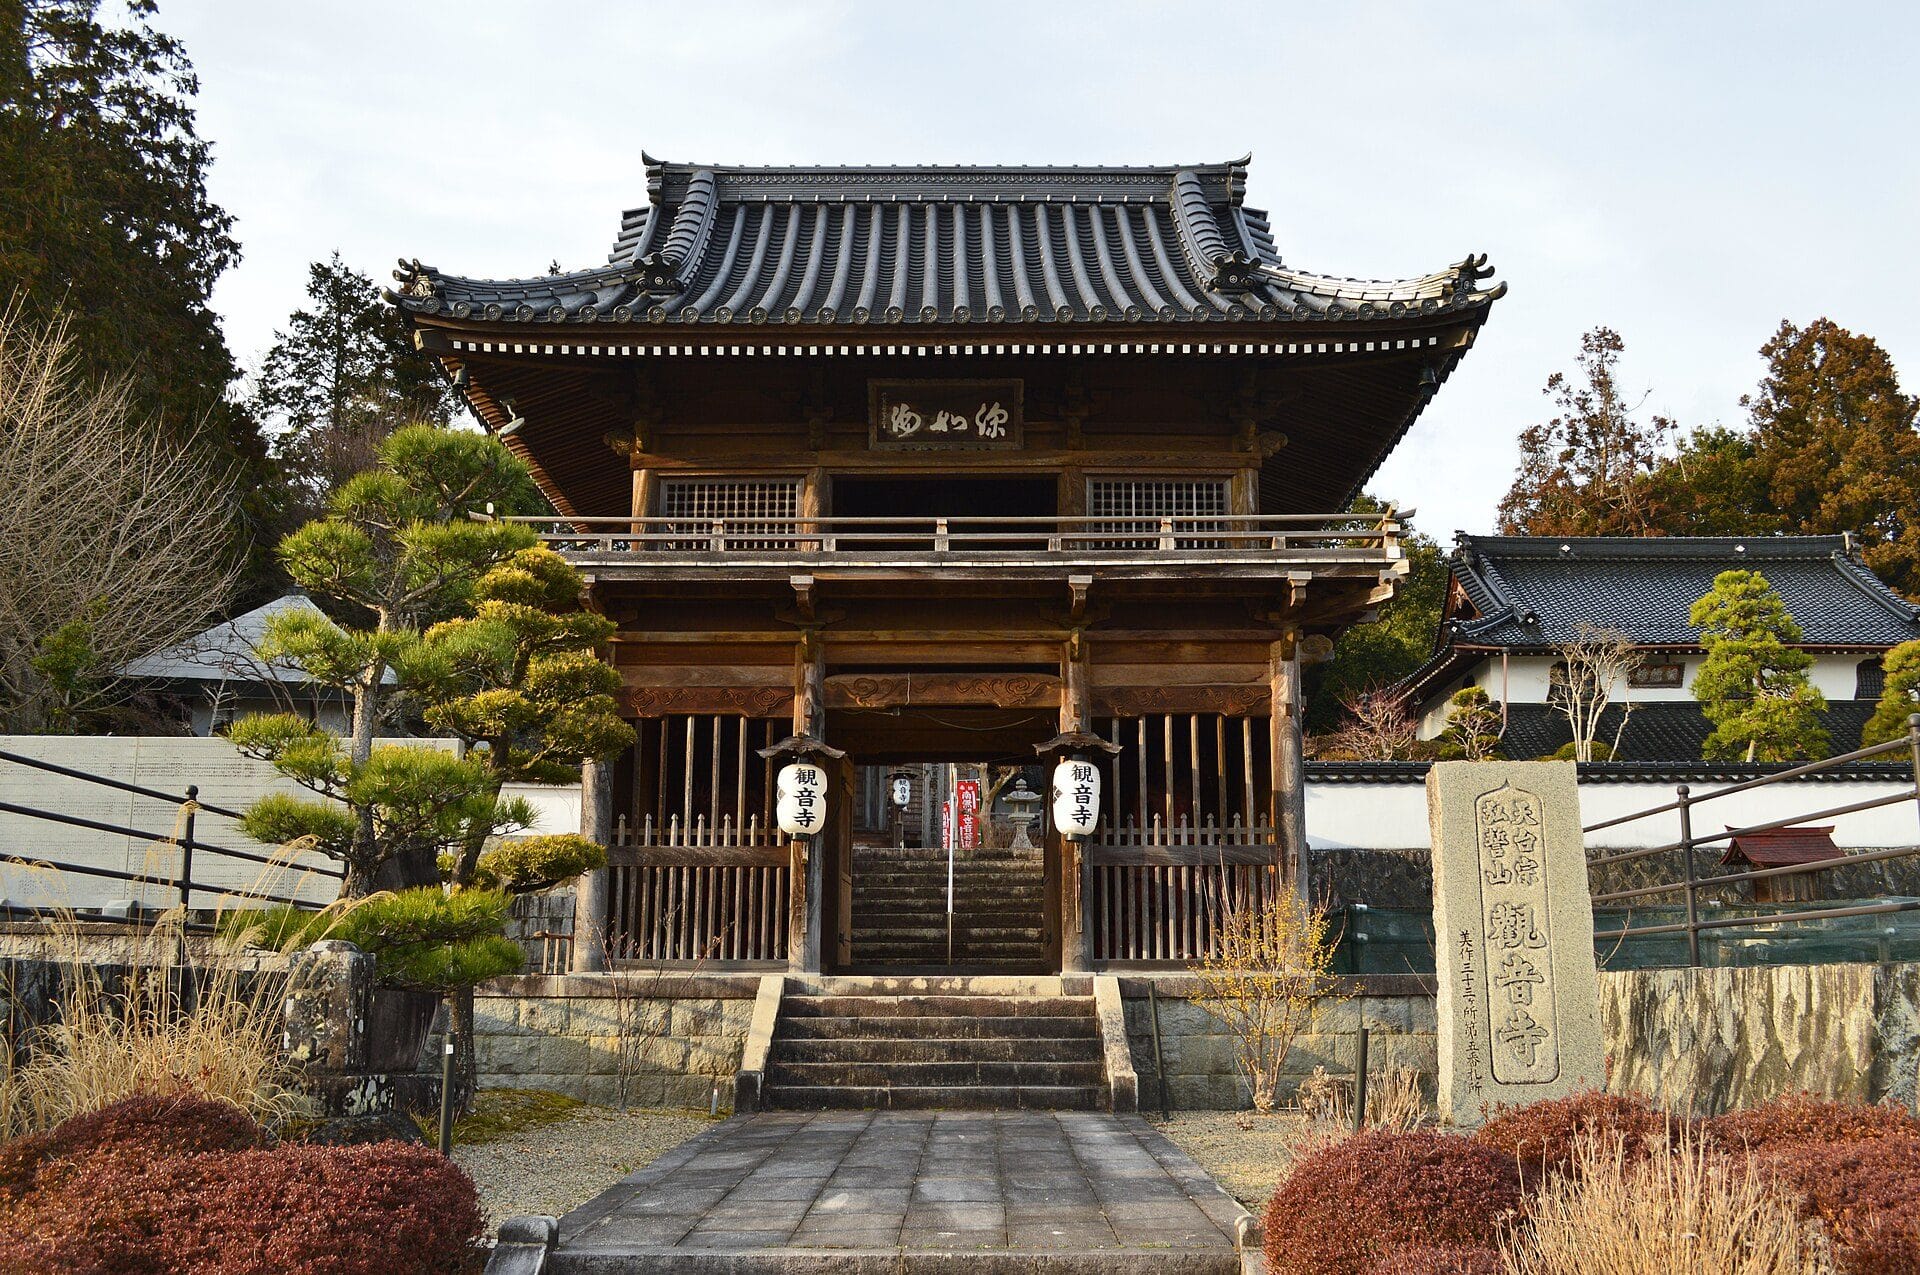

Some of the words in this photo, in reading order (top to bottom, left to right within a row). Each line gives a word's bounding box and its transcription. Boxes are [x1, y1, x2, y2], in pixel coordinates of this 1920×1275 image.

[793, 768, 818, 828] 観音寺
[1070, 764, 1094, 827] 観音寺
[1511, 800, 1540, 887] 天台宗
